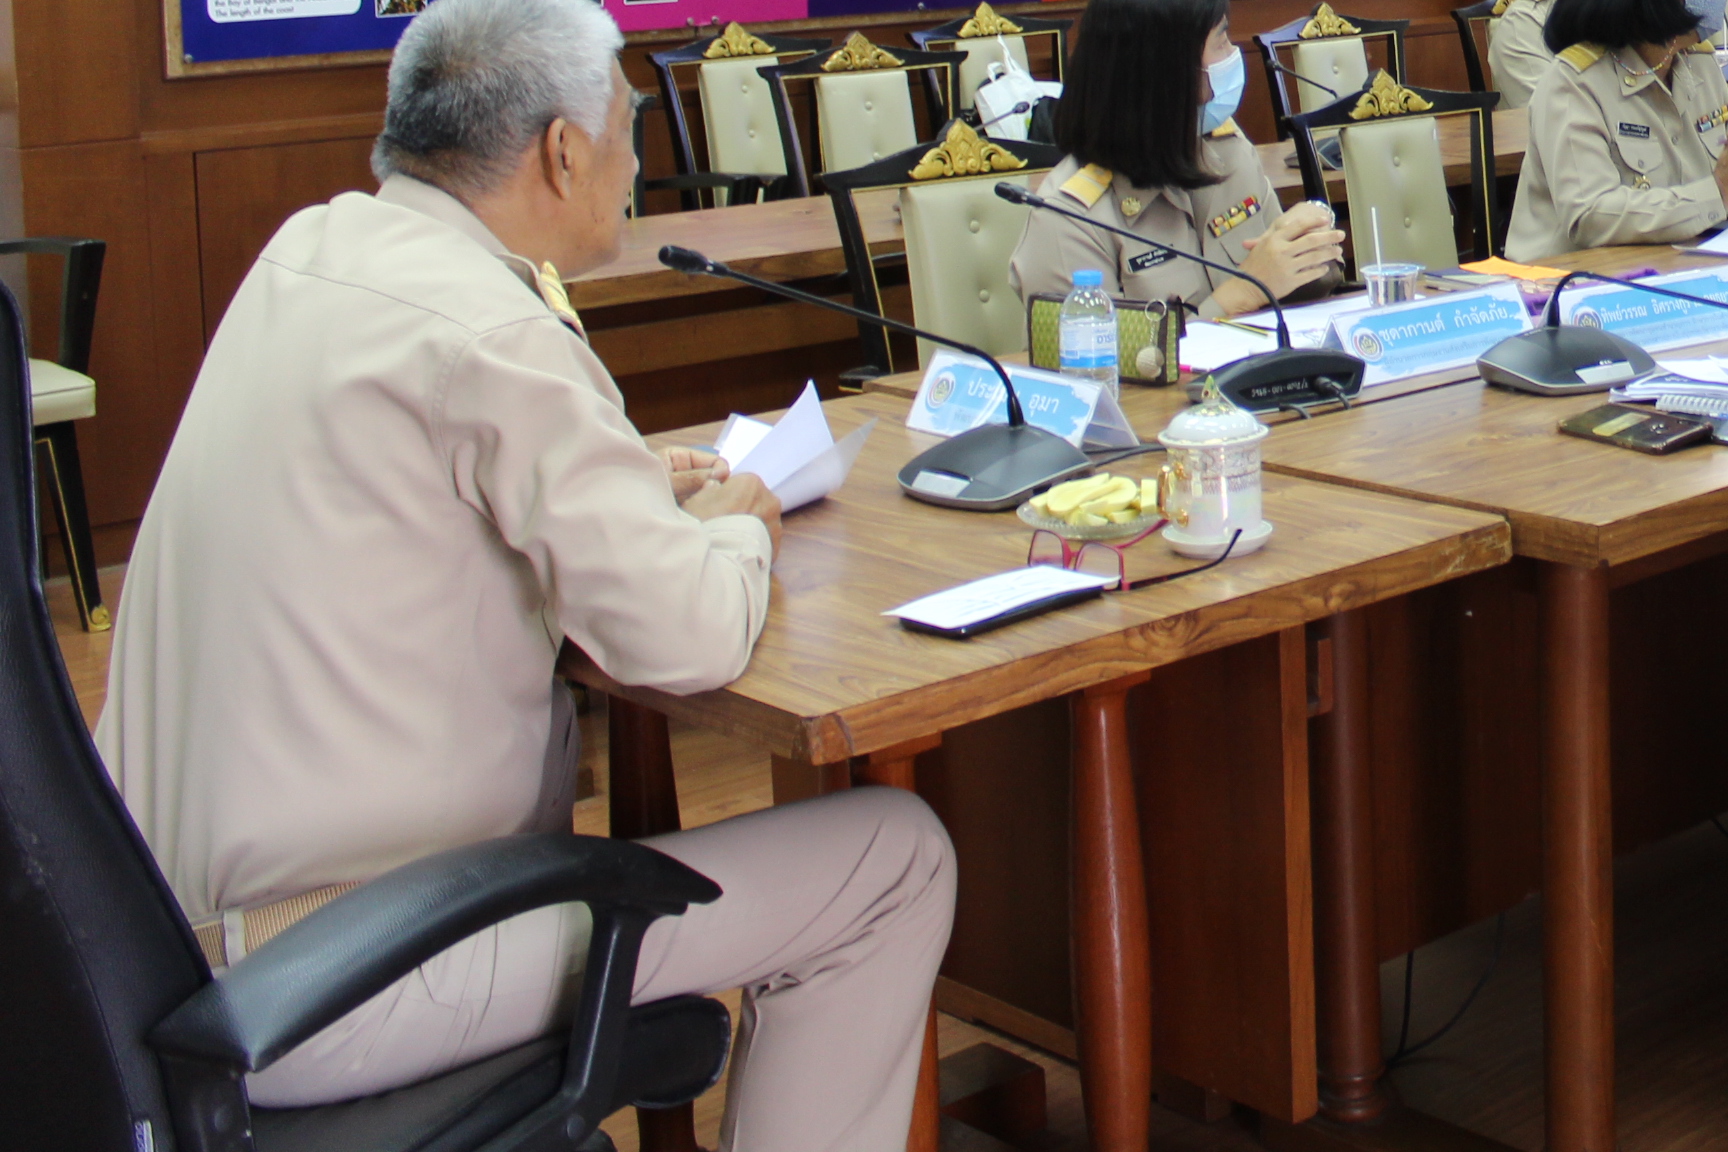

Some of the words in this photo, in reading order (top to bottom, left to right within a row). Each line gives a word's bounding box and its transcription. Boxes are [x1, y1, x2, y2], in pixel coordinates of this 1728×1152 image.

[1378, 312, 1445, 347] ชุดากานต์
[1454, 302, 1508, 328] กำจัดภัย
[1600, 303, 1648, 323] ทิพย์วรรณ
[1028, 393, 1060, 417] อุมา
